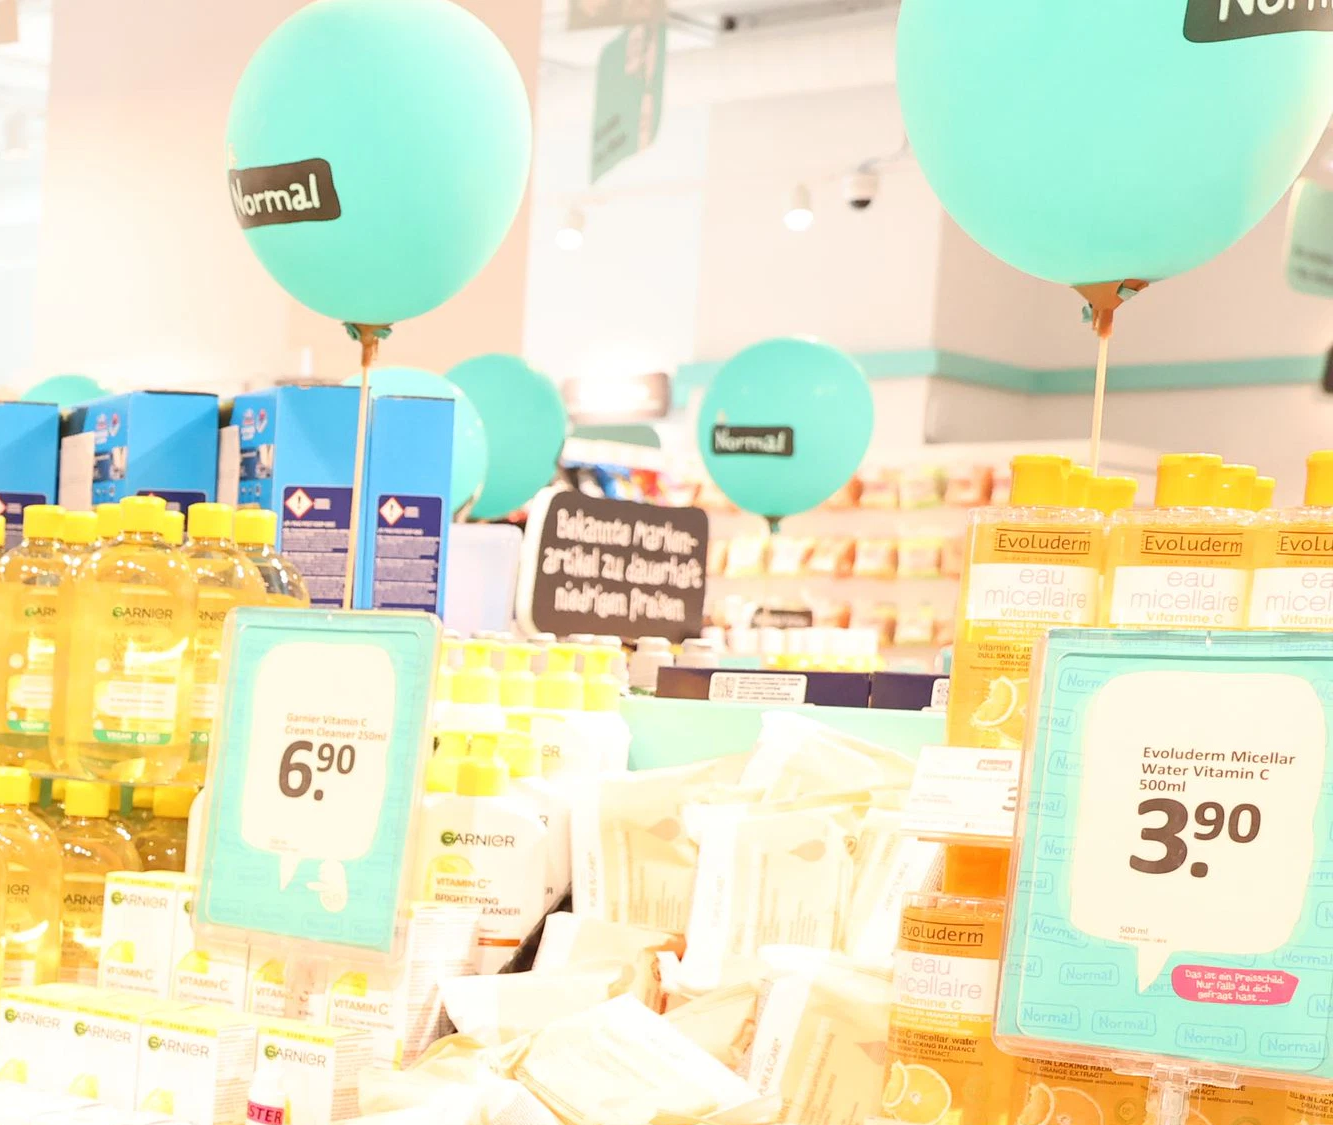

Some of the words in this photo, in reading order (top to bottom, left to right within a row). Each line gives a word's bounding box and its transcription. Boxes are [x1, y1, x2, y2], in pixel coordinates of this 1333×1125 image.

[232, 173, 320, 217] Normal
[713, 428, 786, 452] Normal
[997, 533, 1090, 552] Evoluderm
[1019, 568, 1064, 585] eau
[1167, 570, 1214, 587] eau
[984, 588, 1086, 609] micellaire
[111, 606, 174, 621] GARNIER
[1143, 746, 1226, 763] Evoluderm
[1231, 751, 1296, 766] Micellar
[278, 740, 356, 801] 6.90
[1141, 763, 1189, 777] Water
[1193, 765, 1255, 780] Vitamin
[1259, 768, 1269, 781] C
[1139, 778, 1186, 793] 500ml
[441, 831, 516, 848] GARNIER
[1129, 797, 1262, 878] 3.90
[247, 1105, 283, 1125] STER
